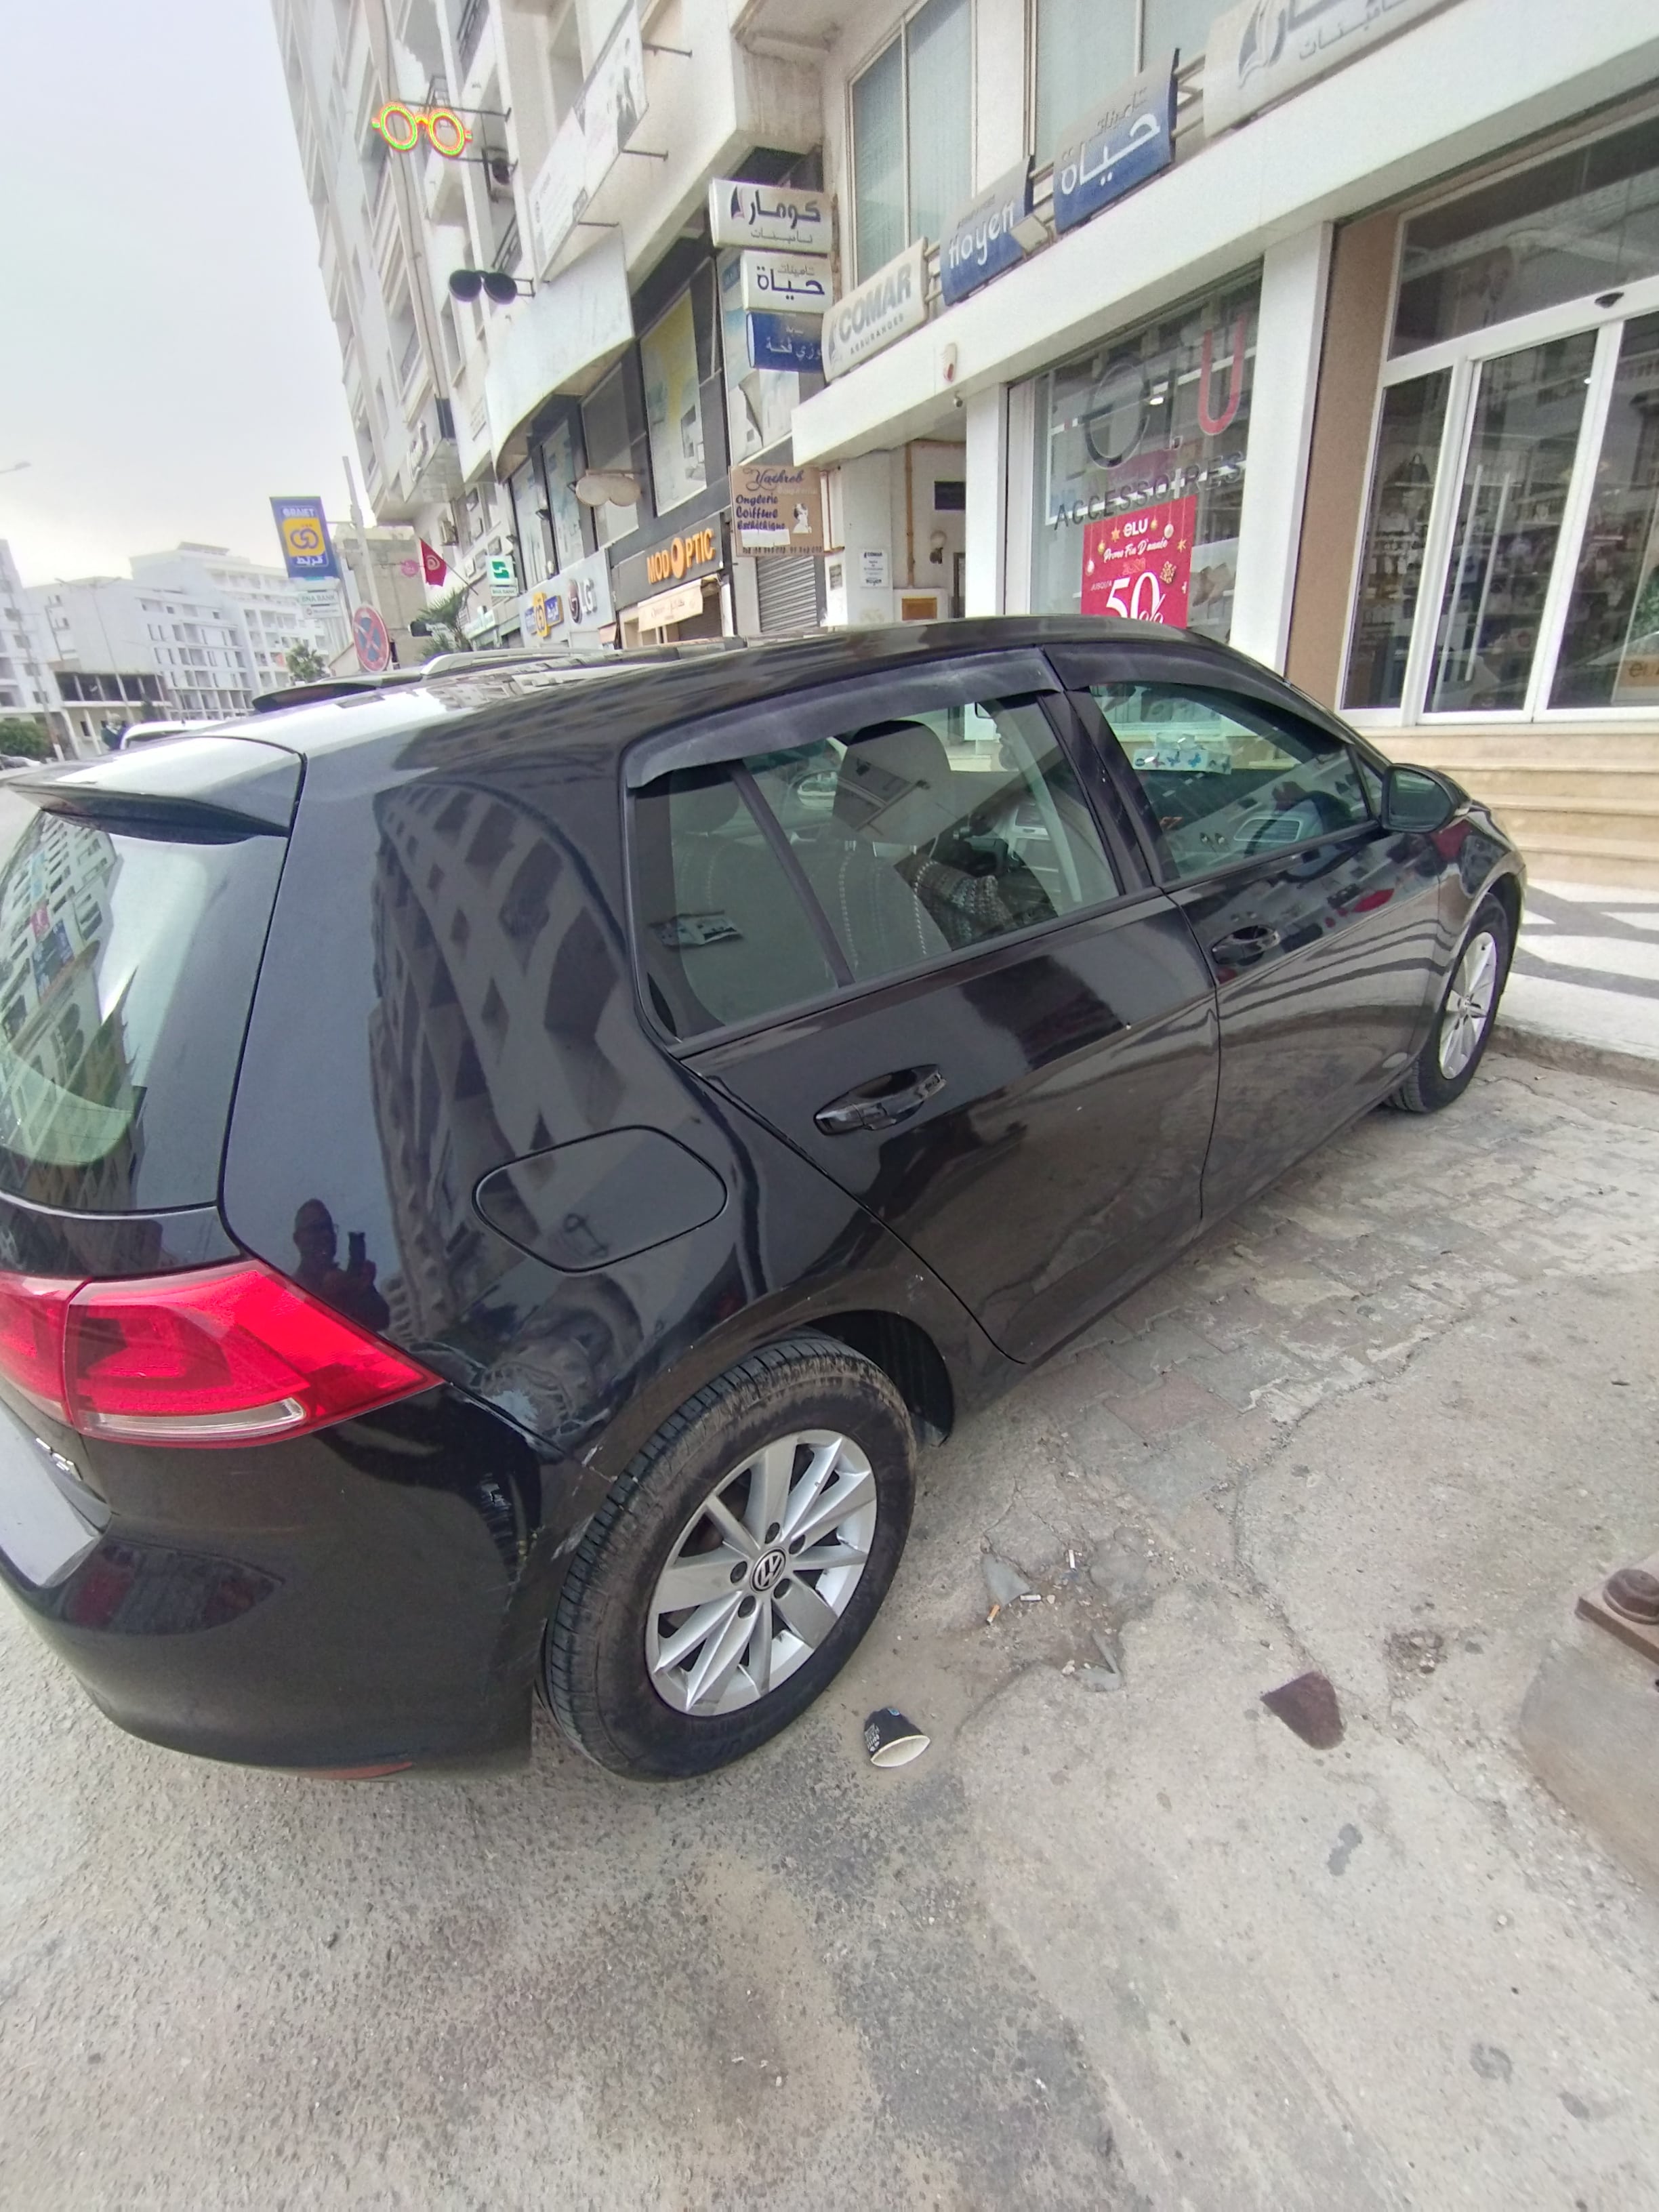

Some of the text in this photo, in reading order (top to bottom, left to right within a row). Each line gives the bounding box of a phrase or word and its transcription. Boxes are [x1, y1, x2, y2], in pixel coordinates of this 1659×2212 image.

[1061, 112, 1161, 195] حياة
[747, 189, 821, 230] كومار
[756, 265, 825, 301] حياة
[839, 263, 912, 343] COMAR
[736, 493, 778, 506] Onglerie
[1054, 450, 1245, 531] ACCESSOIRES
[736, 506, 778, 519] Coiffure
[1125, 543, 1136, 558] Fin
